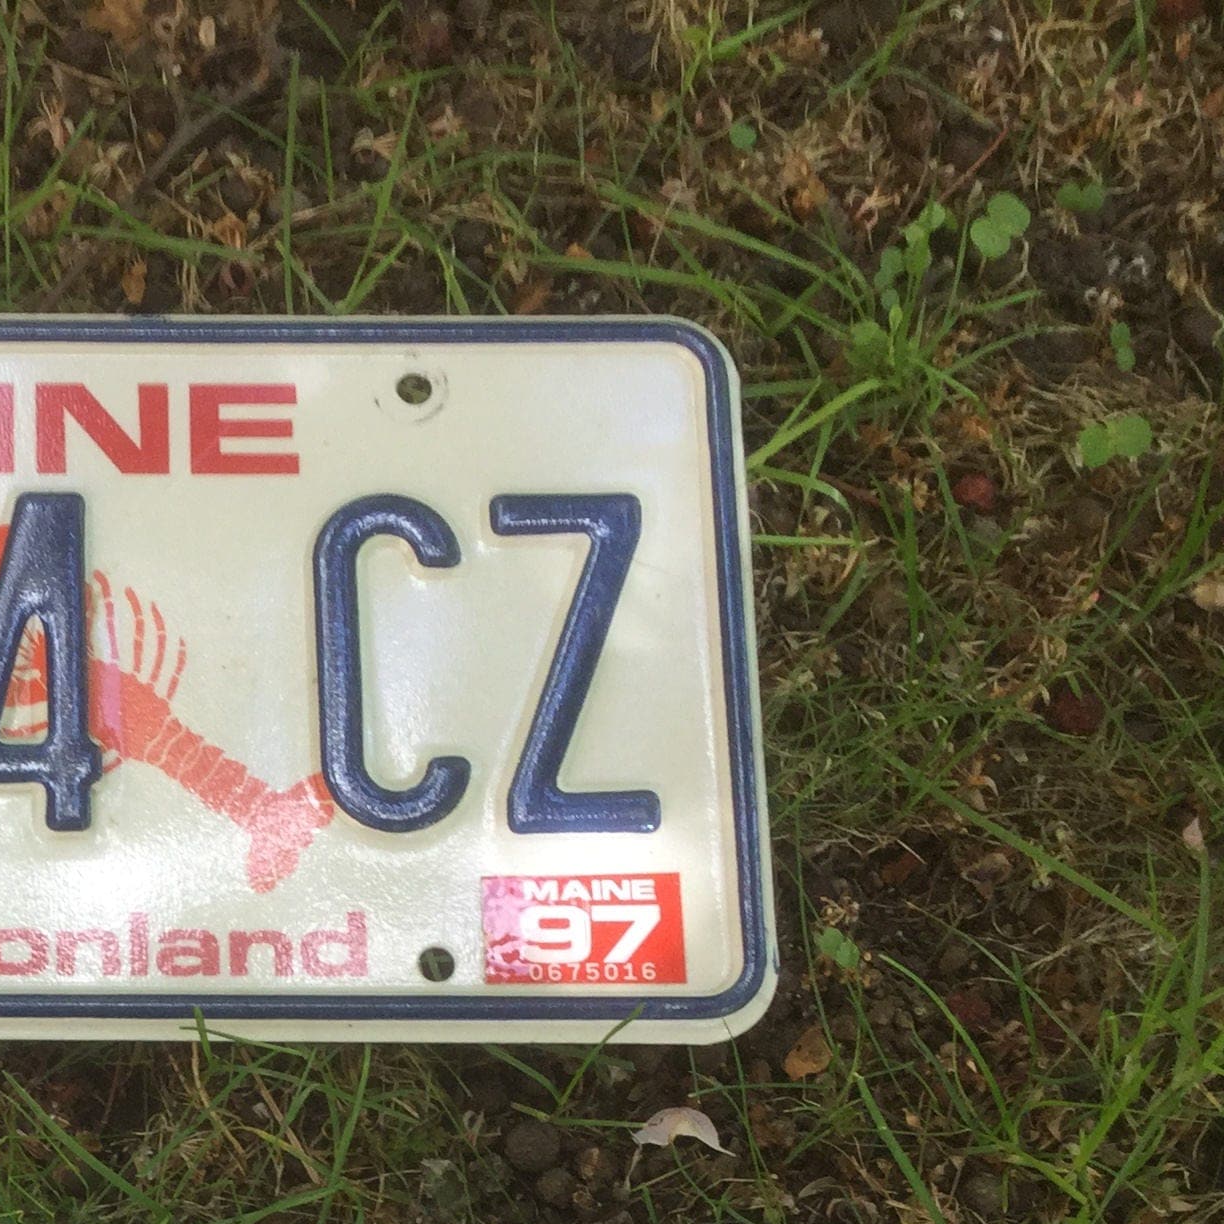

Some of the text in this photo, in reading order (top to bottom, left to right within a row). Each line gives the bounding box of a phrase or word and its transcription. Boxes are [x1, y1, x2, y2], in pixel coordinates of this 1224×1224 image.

[310, 489, 664, 834] CZ
[522, 879, 656, 901] MAINE
[519, 903, 662, 964] 97
[529, 961, 657, 981] 0675016
